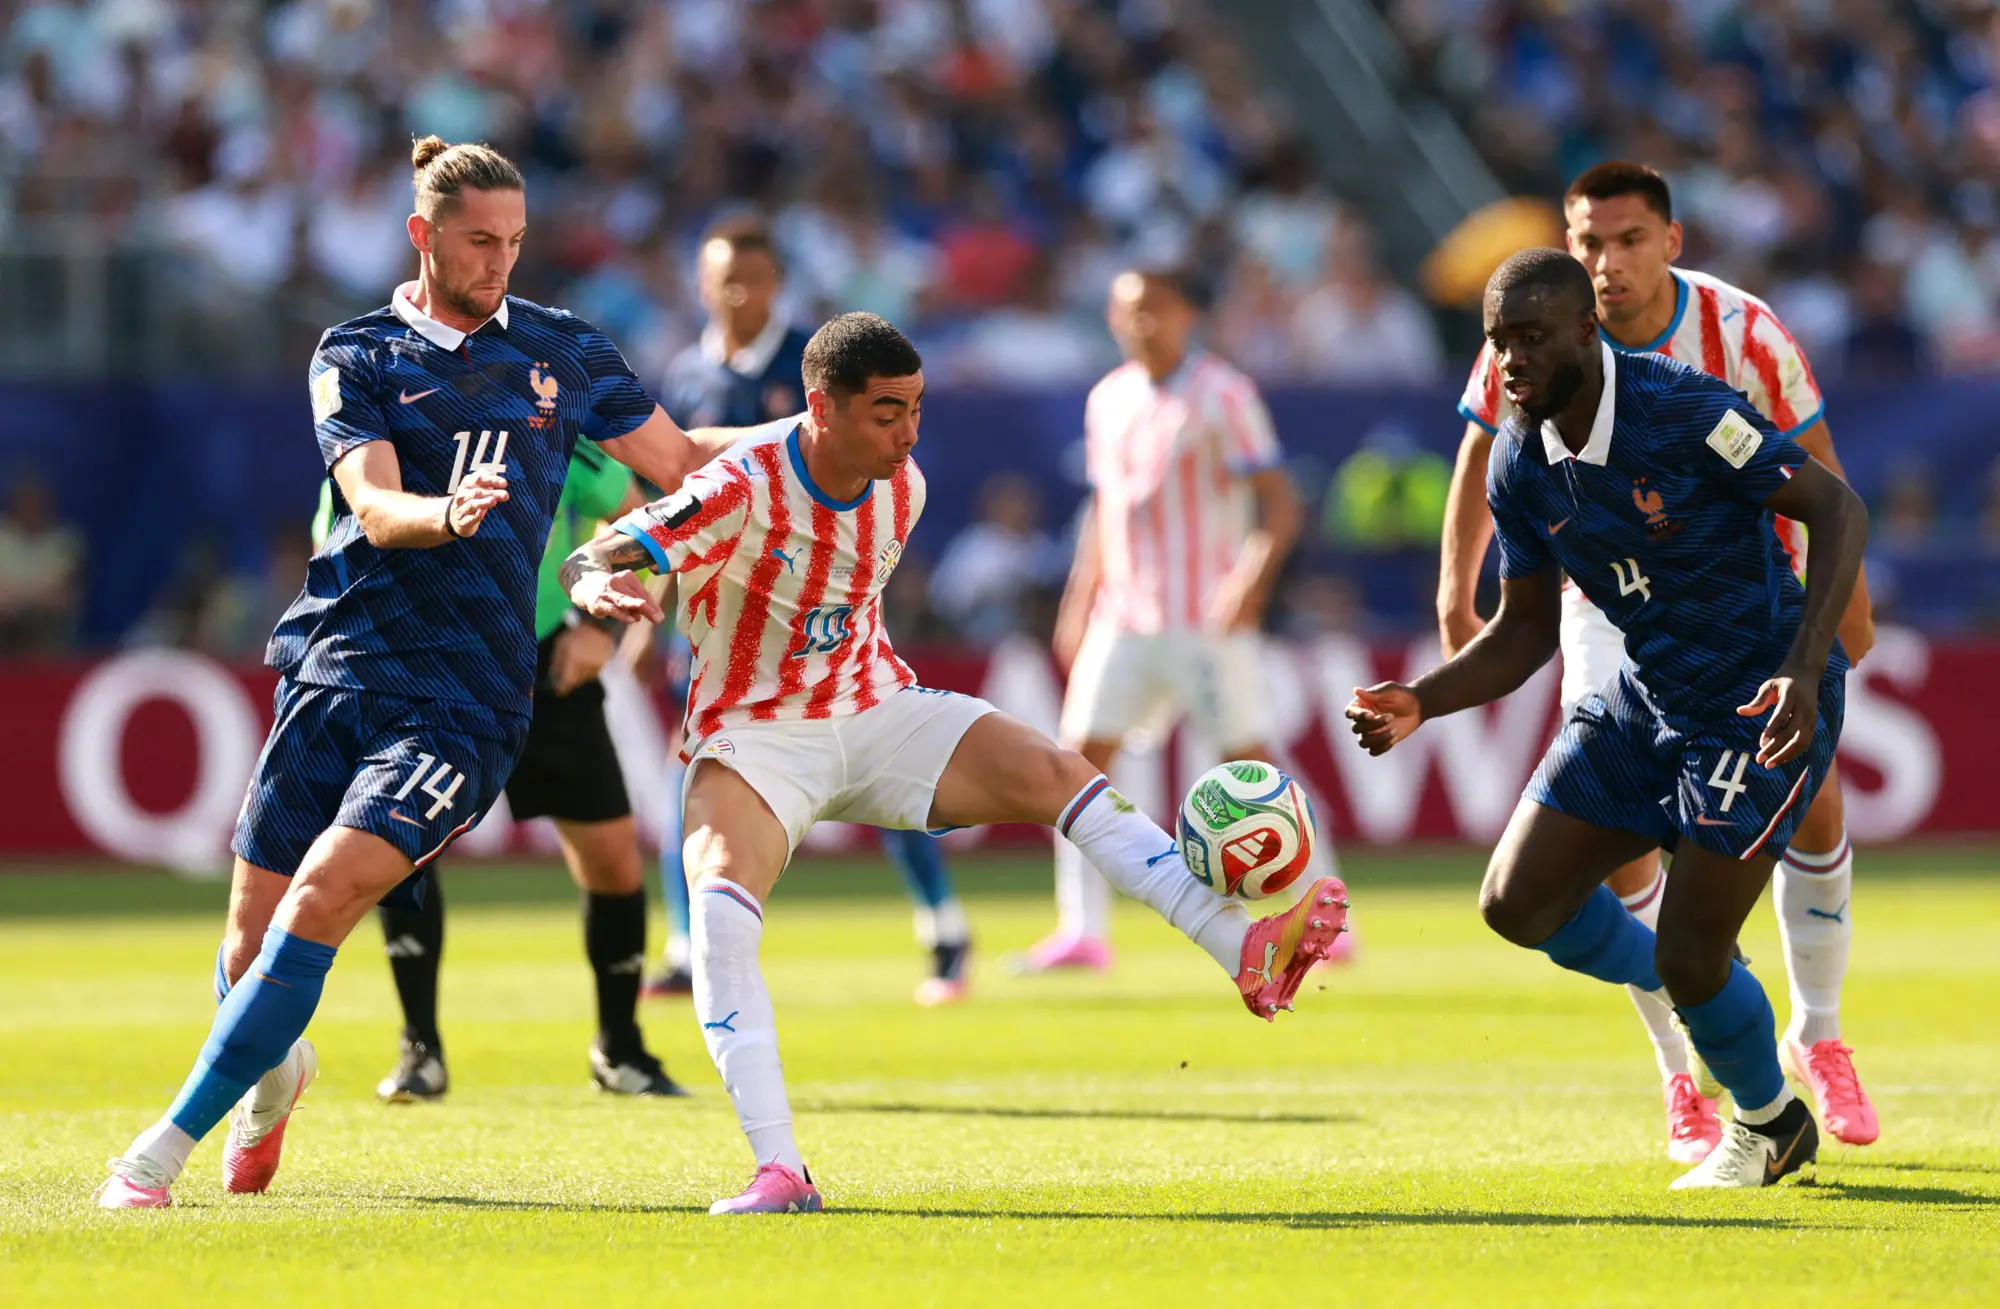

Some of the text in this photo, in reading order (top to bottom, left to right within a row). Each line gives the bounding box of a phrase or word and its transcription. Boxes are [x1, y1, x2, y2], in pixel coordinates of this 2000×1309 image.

[447, 430, 508, 494] 14
[1609, 558, 1651, 603] 4
[792, 604, 854, 659] 10
[393, 752, 465, 820] 14
[1196, 794, 1218, 823] TRIONDA
[1706, 749, 1750, 812] 4
